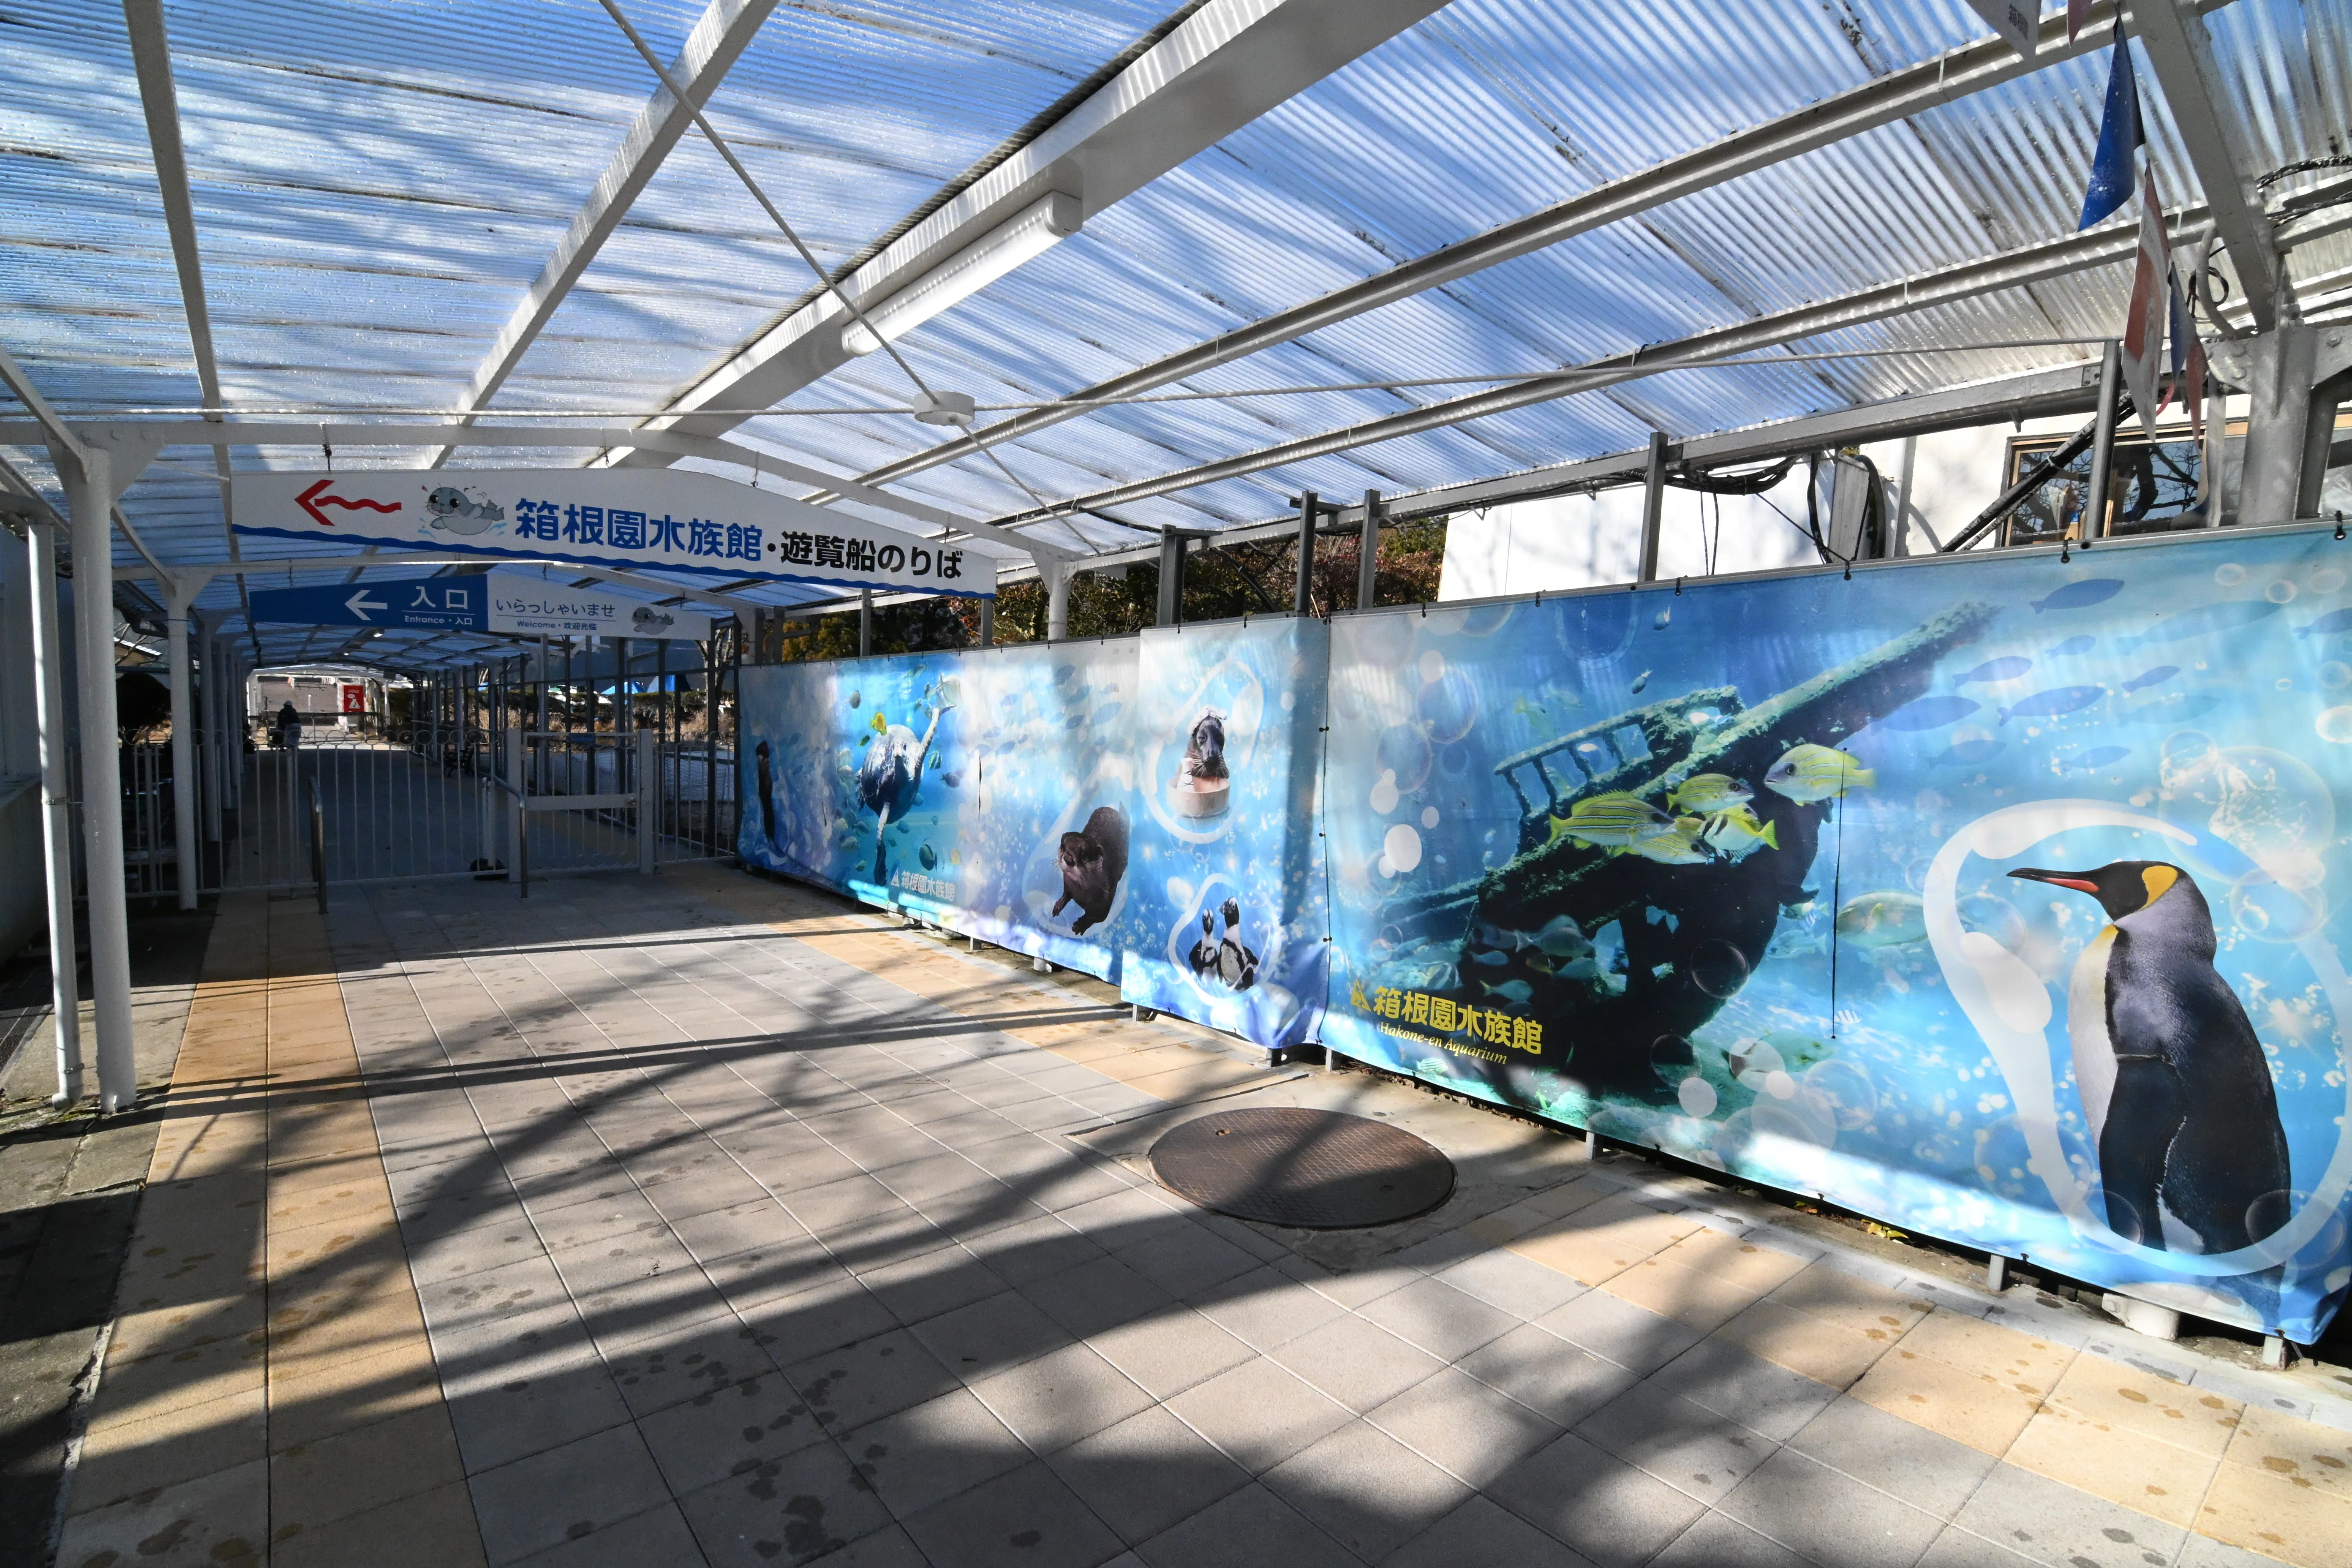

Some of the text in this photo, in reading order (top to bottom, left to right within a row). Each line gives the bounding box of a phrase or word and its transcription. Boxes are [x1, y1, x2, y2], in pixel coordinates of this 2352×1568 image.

[411, 586, 468, 609] 入口
[496, 599, 615, 617] いらっしゃいませ
[405, 615, 445, 624] Entrance
[1374, 985, 1542, 1054] 箱根園水族館
[1380, 1021, 1508, 1064] Hakone-en Aquarium
